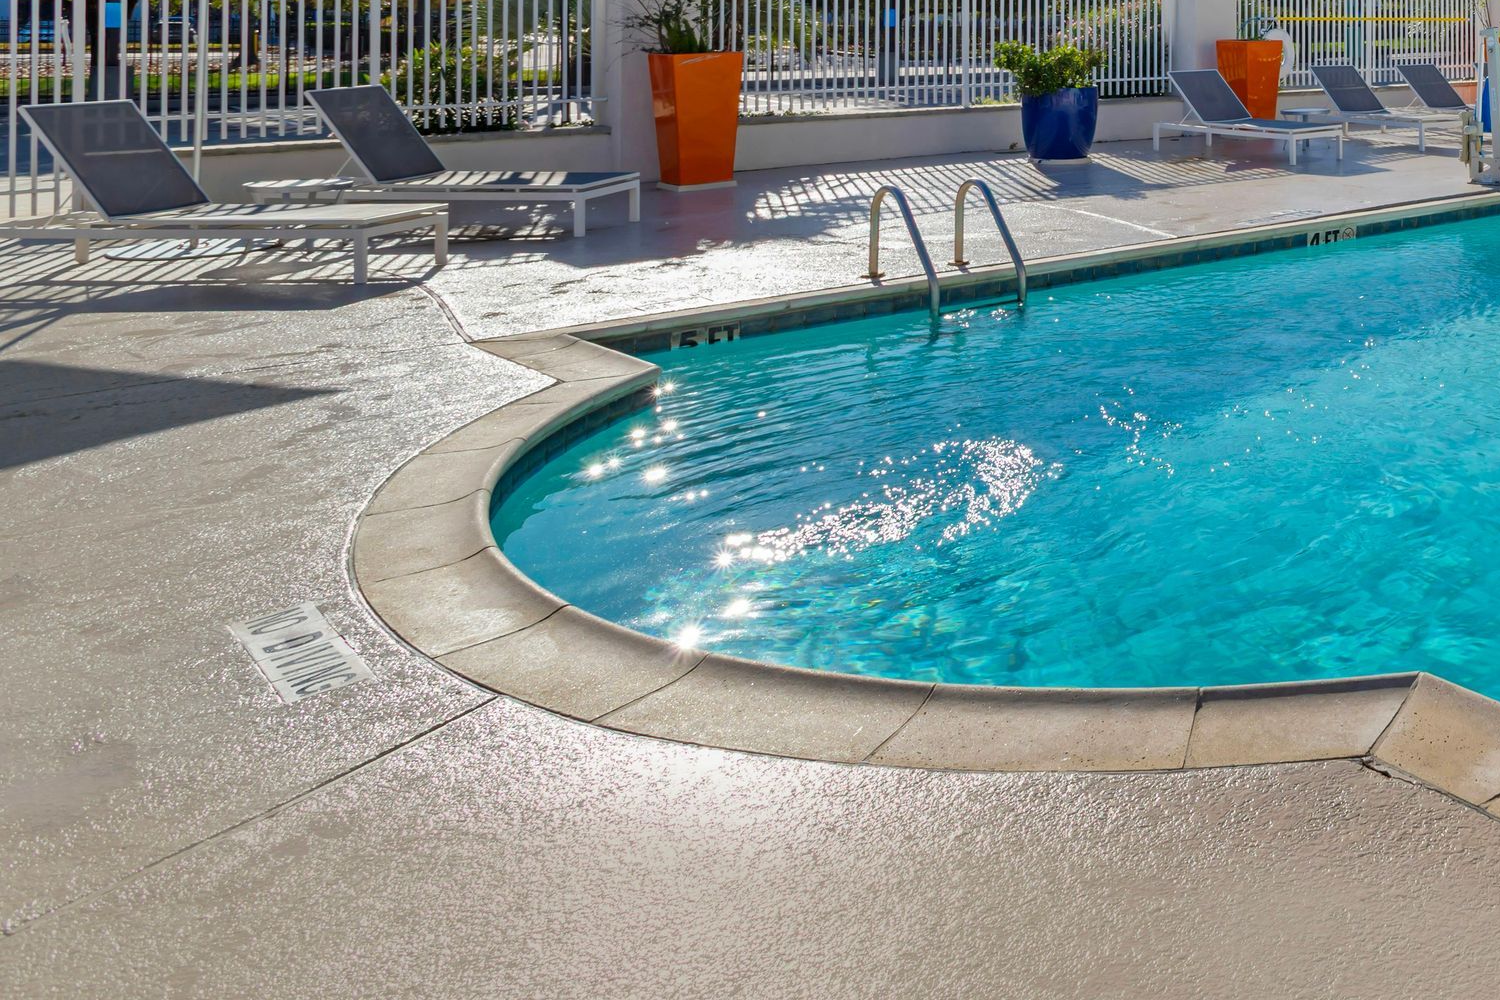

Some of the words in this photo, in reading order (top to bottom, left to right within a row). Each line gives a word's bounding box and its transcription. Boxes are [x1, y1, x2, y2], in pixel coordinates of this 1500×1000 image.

[1325, 230, 1340, 244] FT
[680, 329, 698, 347] 5
[708, 323, 739, 344] FT
[244, 606, 308, 635] NO
[262, 631, 357, 694] DIVING
